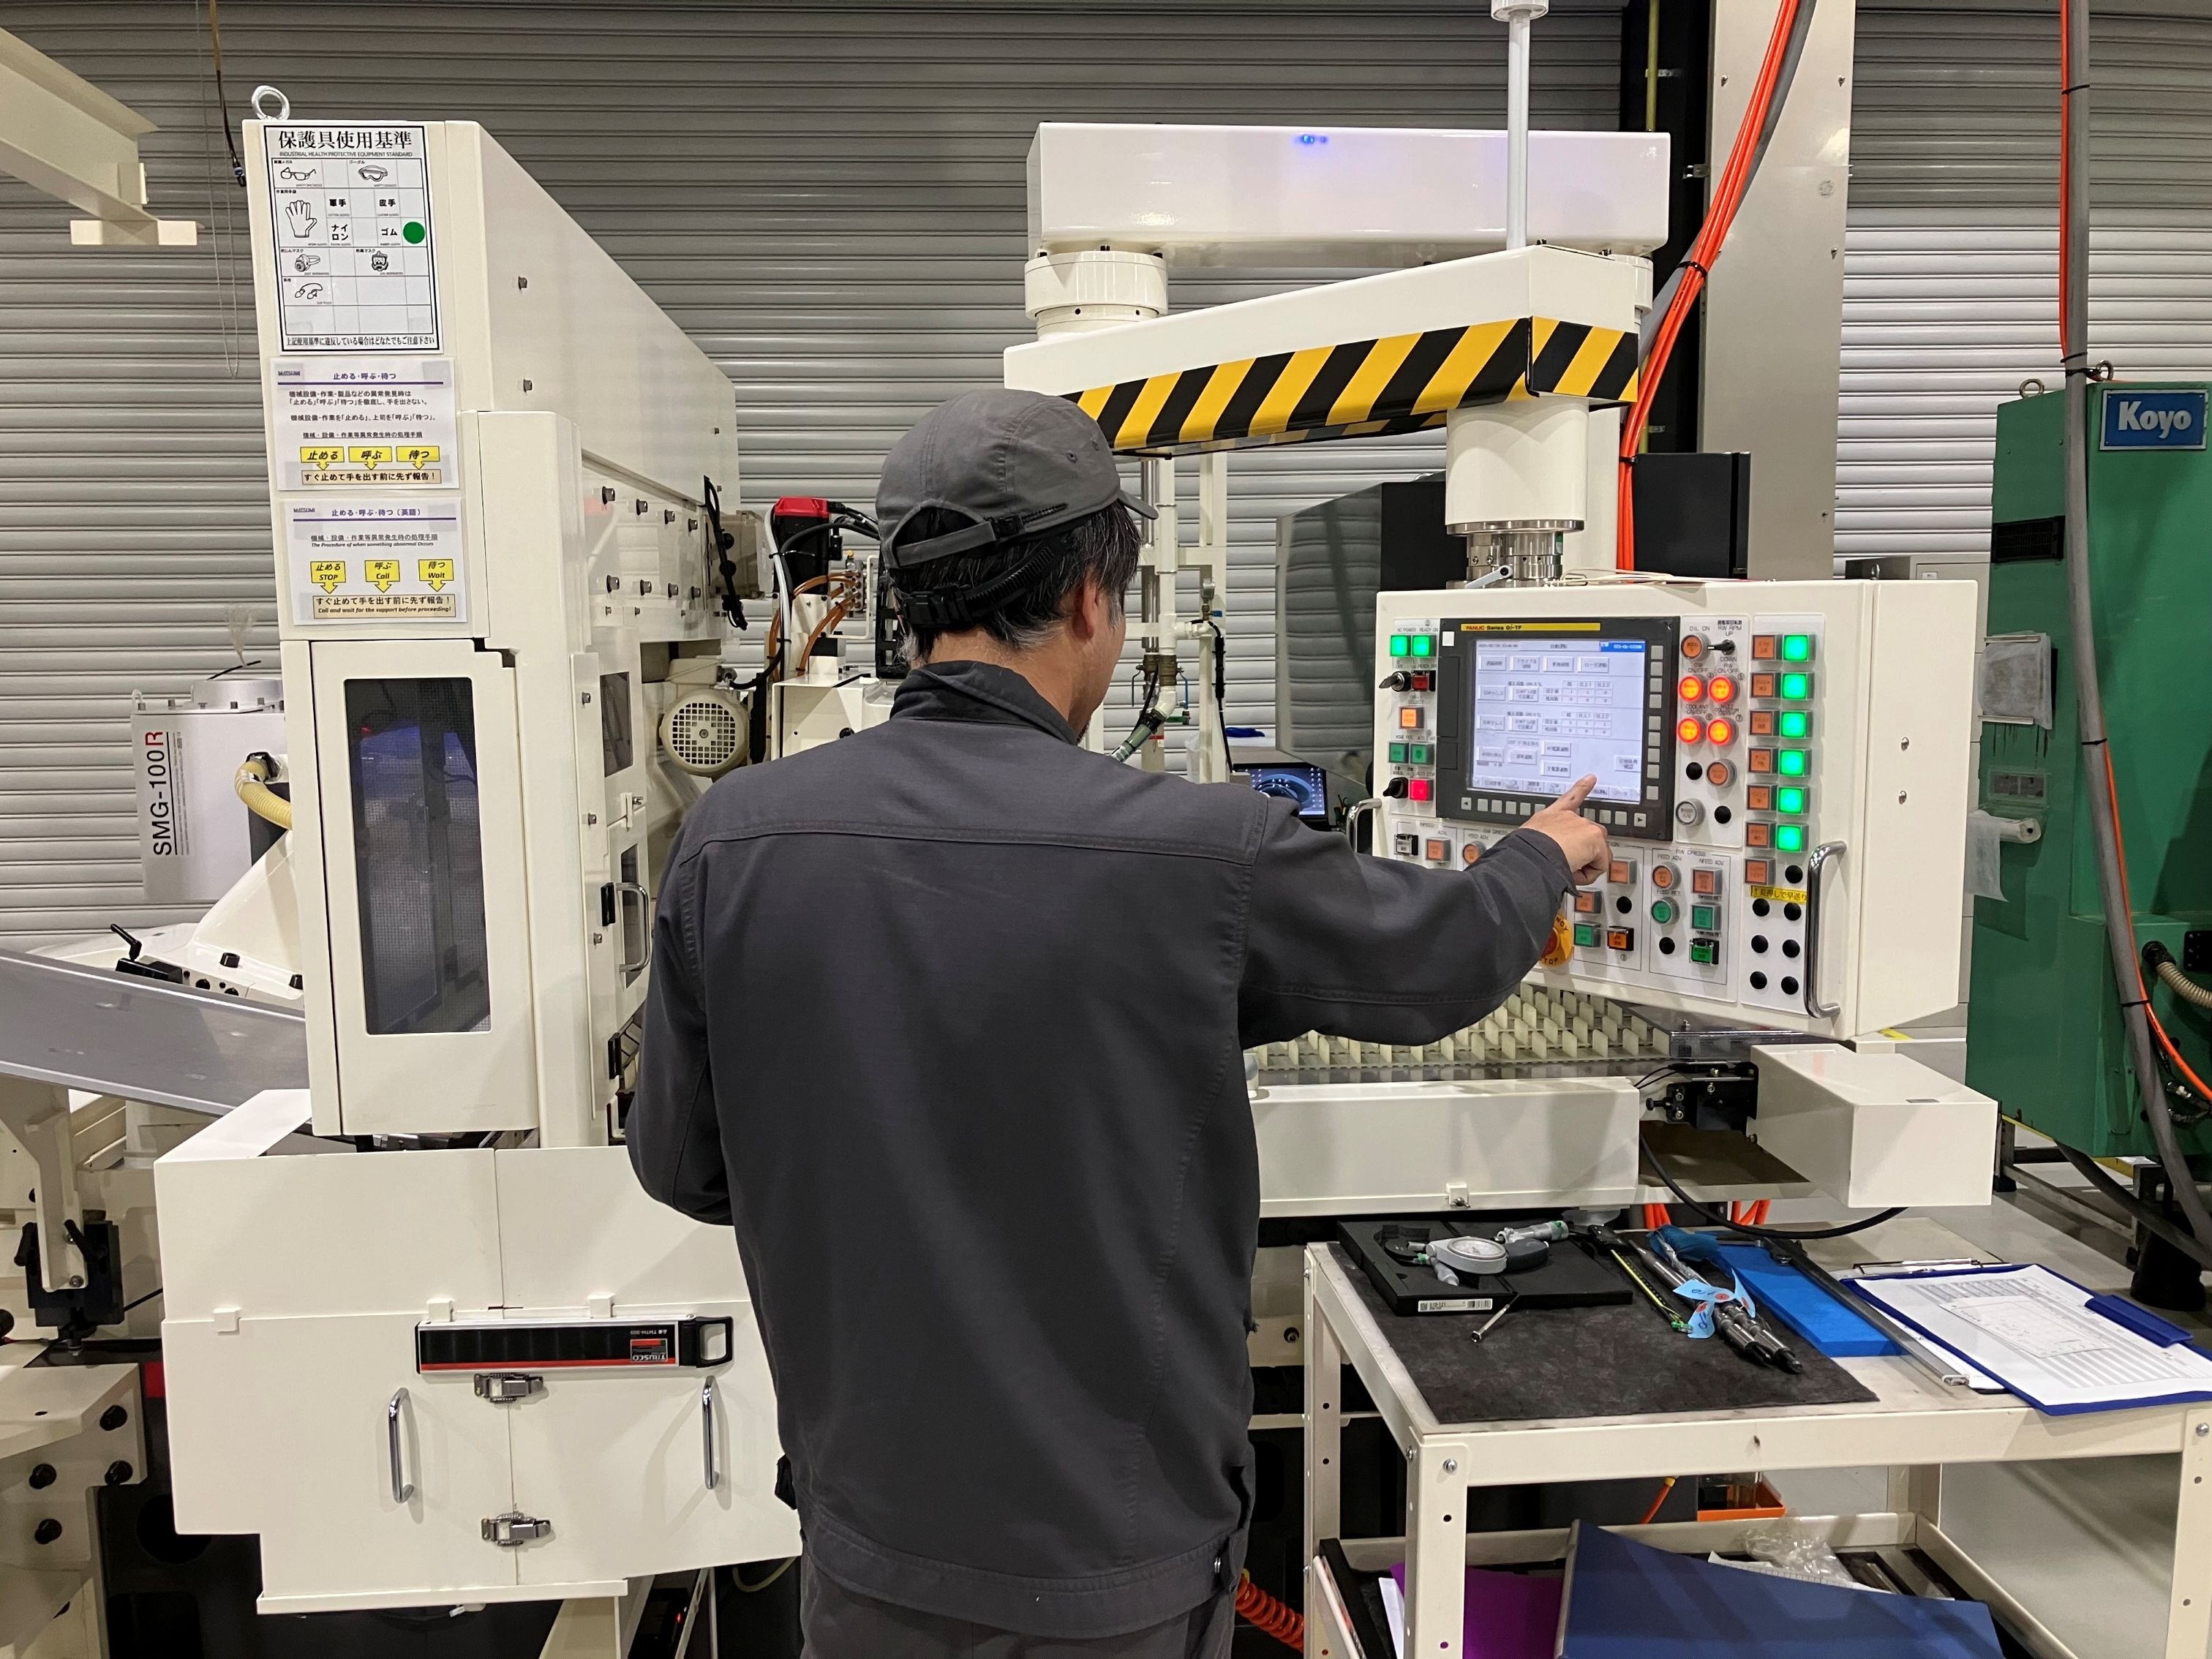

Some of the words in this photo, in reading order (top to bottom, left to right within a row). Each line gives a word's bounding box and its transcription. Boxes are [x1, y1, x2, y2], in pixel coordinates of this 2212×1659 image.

[279, 130, 412, 149] 保護具使用基準
[2118, 401, 2192, 439] Koyo
[307, 450, 339, 460] 止める
[361, 450, 383, 460] 呼ぶ
[408, 450, 429, 459] 待つ
[632, 1353, 666, 1361] TRUSCO
